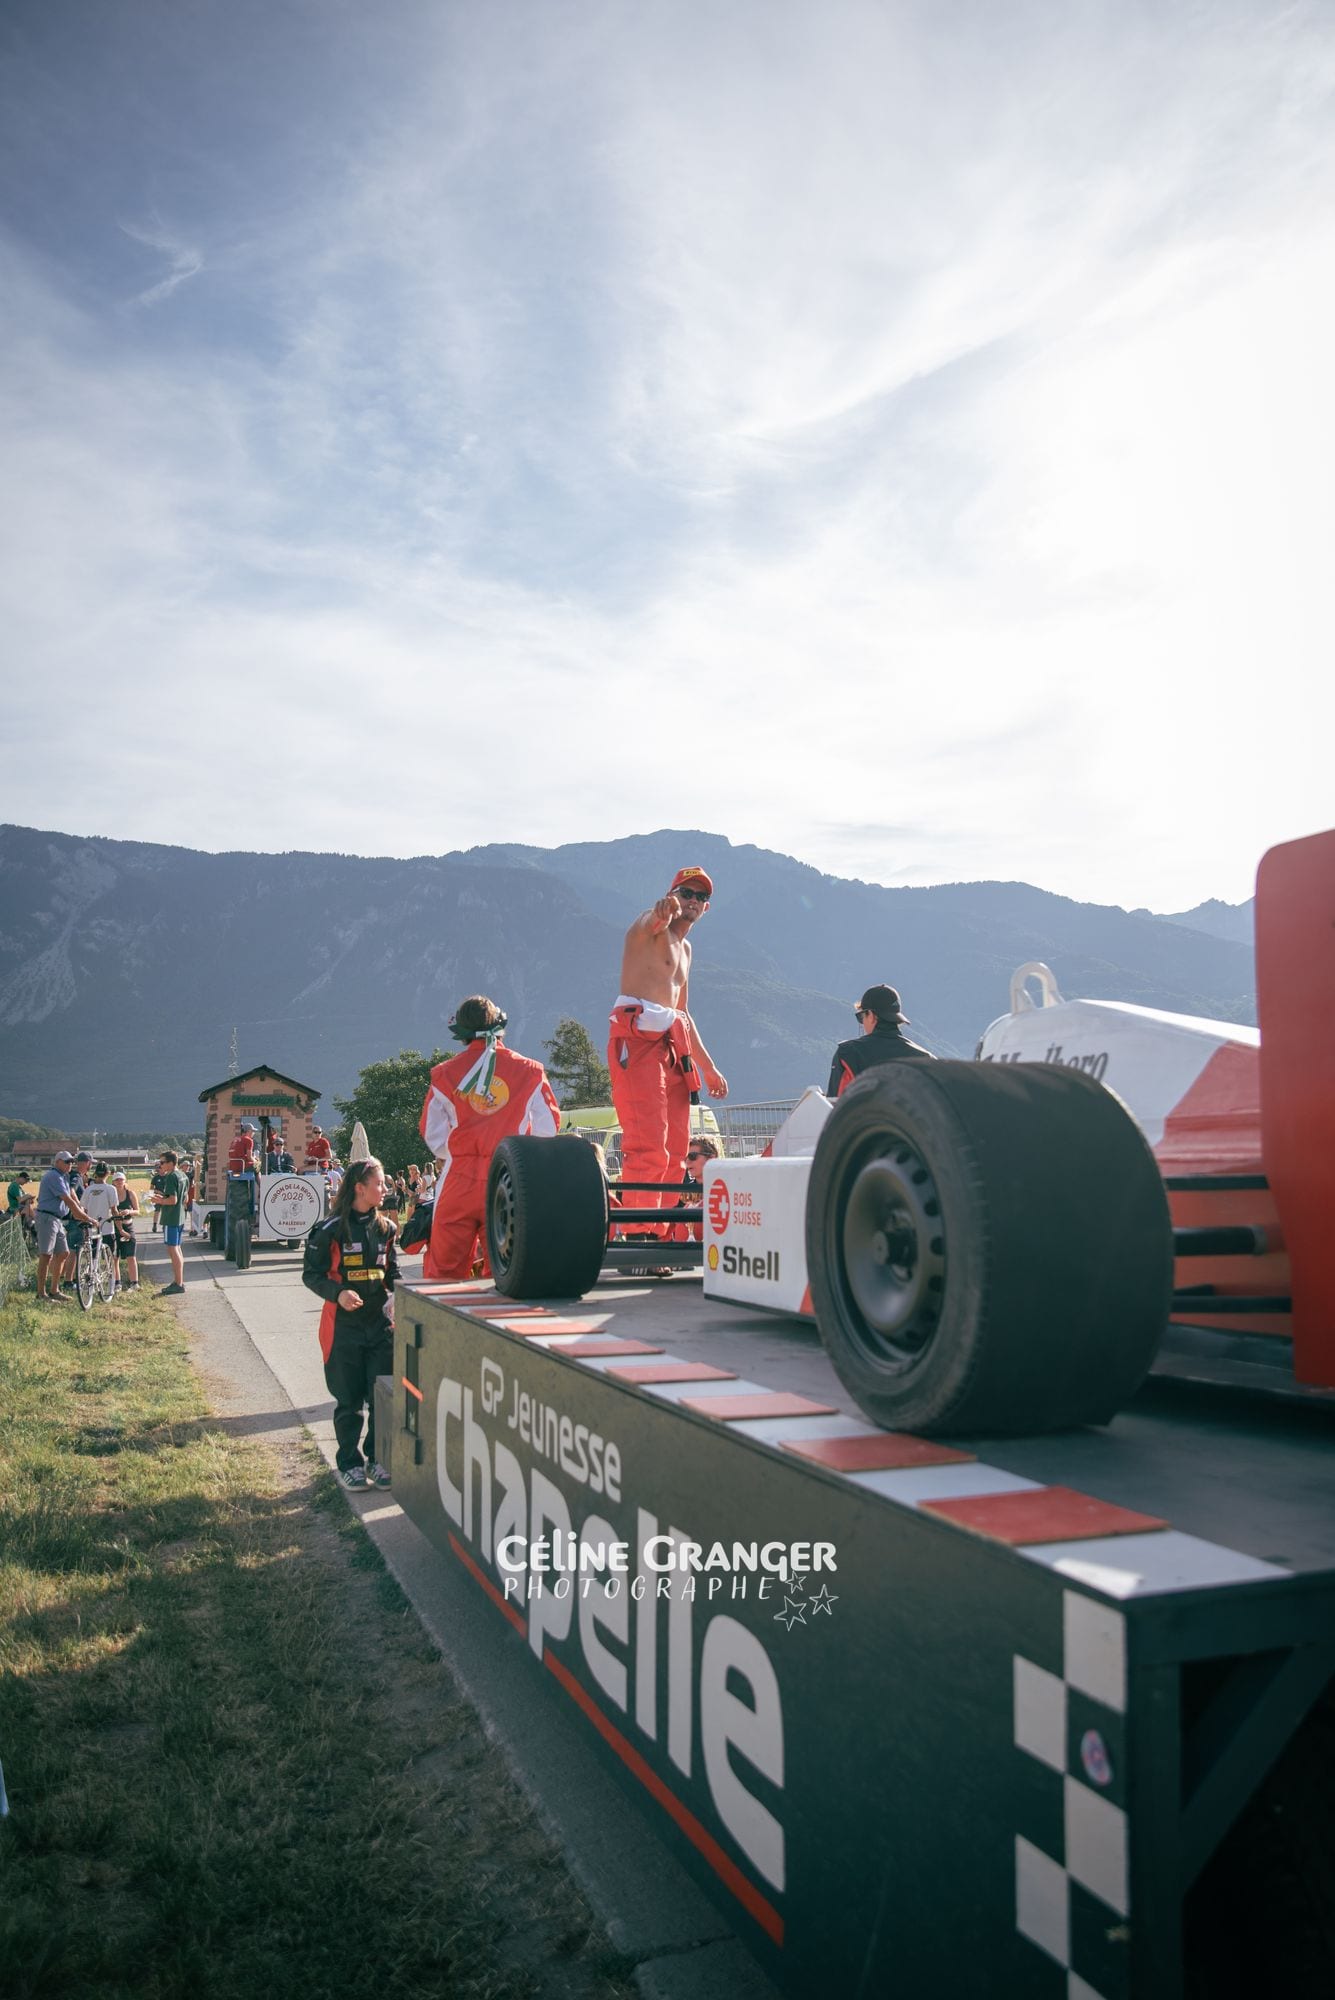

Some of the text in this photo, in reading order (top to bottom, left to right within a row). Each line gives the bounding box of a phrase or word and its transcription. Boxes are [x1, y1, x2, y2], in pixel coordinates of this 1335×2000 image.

[281, 1191, 304, 1201] 2028
[300, 1186, 315, 1203] BROYE
[733, 1192, 752, 1207] BOIS
[733, 1211, 762, 1226] SUISSE
[722, 1245, 780, 1282] Shell
[481, 1356, 622, 1504] GP Jeunesse
[436, 1377, 785, 1893] Chapelle
